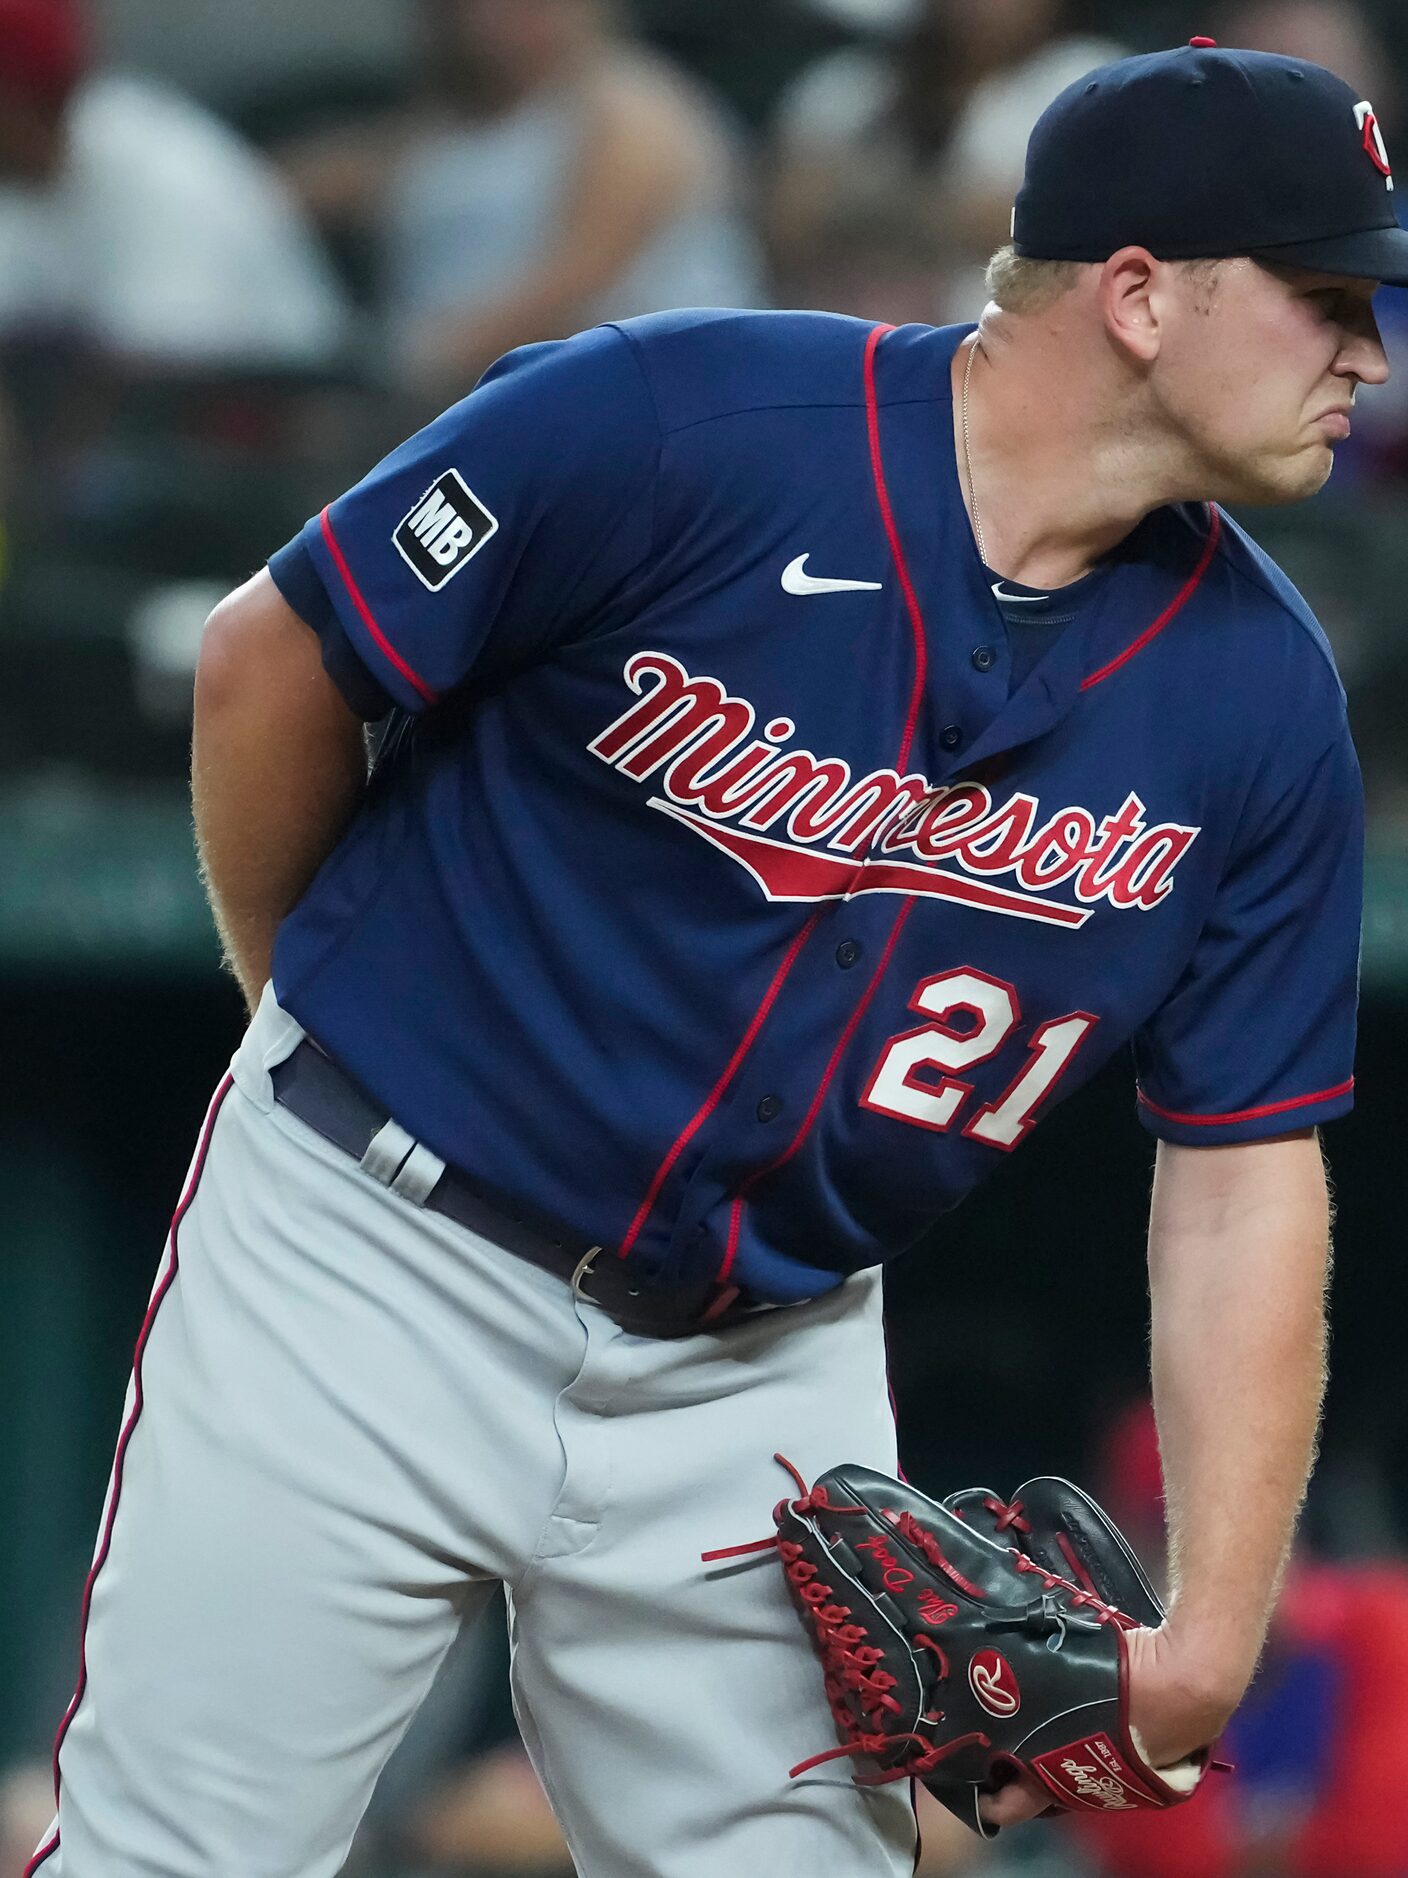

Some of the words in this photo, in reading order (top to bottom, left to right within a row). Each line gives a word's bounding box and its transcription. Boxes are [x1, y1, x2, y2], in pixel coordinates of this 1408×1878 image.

[407, 489, 473, 566] MB
[586, 651, 1202, 910] Minnesota
[858, 964, 1101, 1152] 21
[1060, 1757, 1139, 1810] Rawlings
